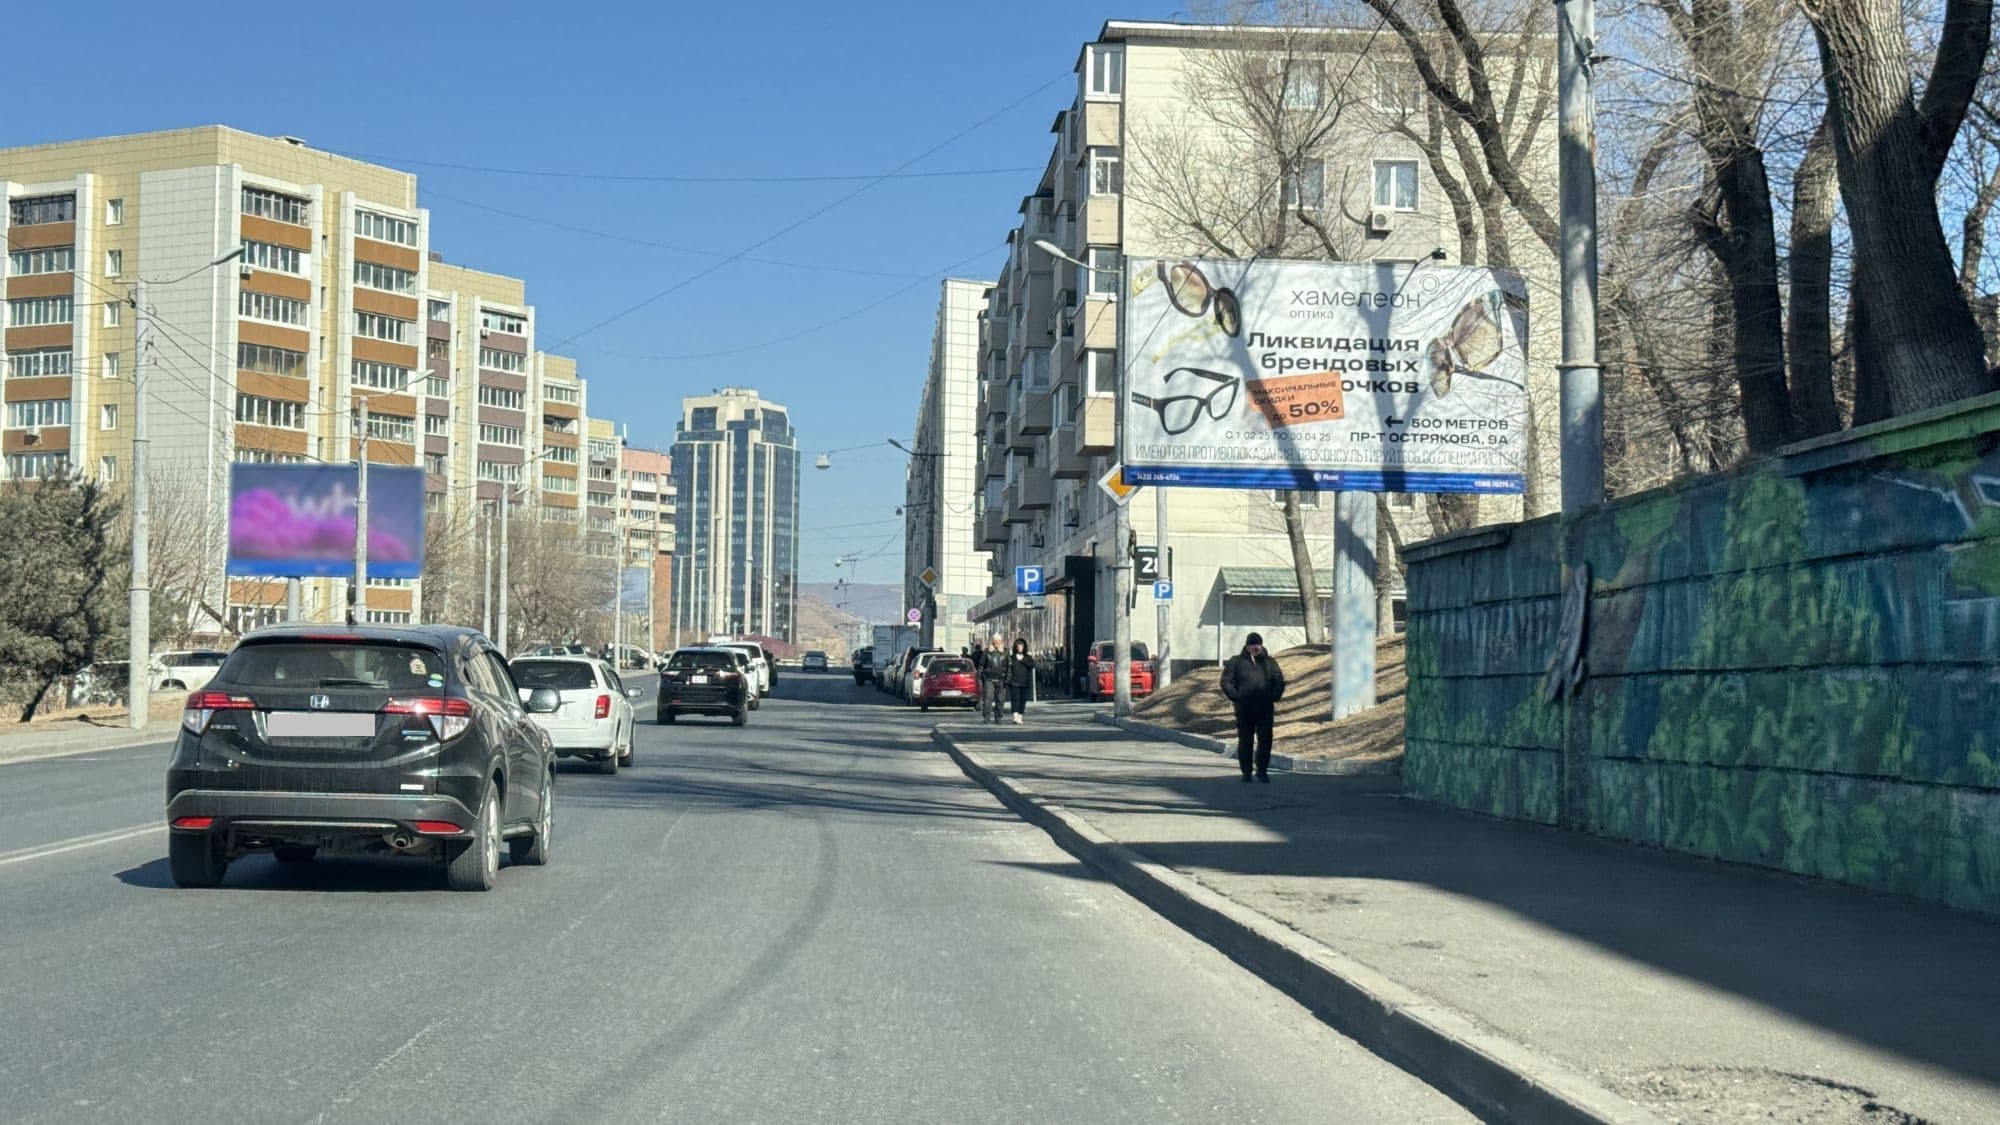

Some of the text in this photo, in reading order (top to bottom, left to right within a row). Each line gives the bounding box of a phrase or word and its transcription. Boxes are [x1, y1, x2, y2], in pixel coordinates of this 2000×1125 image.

[1290, 290, 1420, 308] хамелеон
[1289, 310, 1334, 320] оптика
[1247, 332, 1419, 353] Ликвидация
[1261, 352, 1418, 374] брендовых
[1253, 381, 1337, 395] МАКСИМАЛЬНЫЕ
[1341, 380, 1419, 394] очков
[1254, 395, 1295, 405] СКИДКИ
[1289, 399, 1339, 418] 50%
[1411, 418, 1508, 430] 500 МЕТРОВ
[1273, 431, 1288, 440] ПО
[1350, 432, 1508, 445] ПР-Т ОСТРЯКОВА, 9А
[1136, 444, 1185, 460] ИМЕЮТСЯ
[1024, 569, 1039, 591] P
[1158, 583, 1170, 597] P
